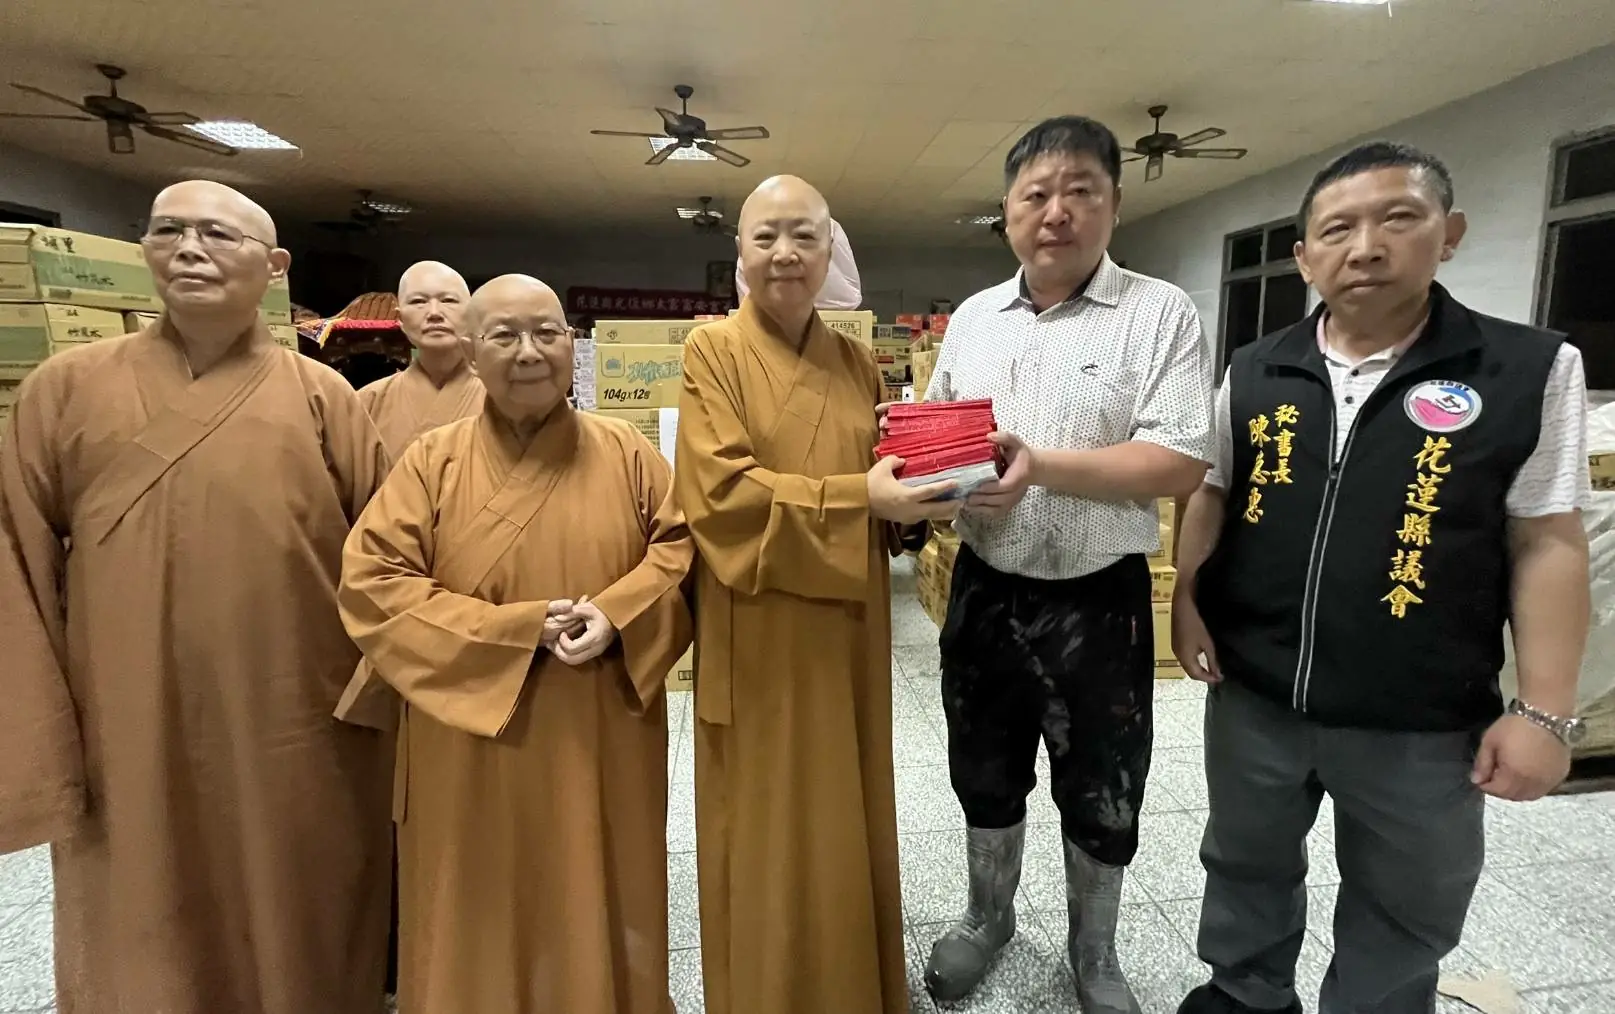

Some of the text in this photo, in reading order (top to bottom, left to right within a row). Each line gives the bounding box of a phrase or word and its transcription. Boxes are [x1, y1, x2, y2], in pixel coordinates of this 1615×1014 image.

[1273, 403, 1300, 484] 秘書長
[1380, 435, 1452, 619] 花蓮縣議會
